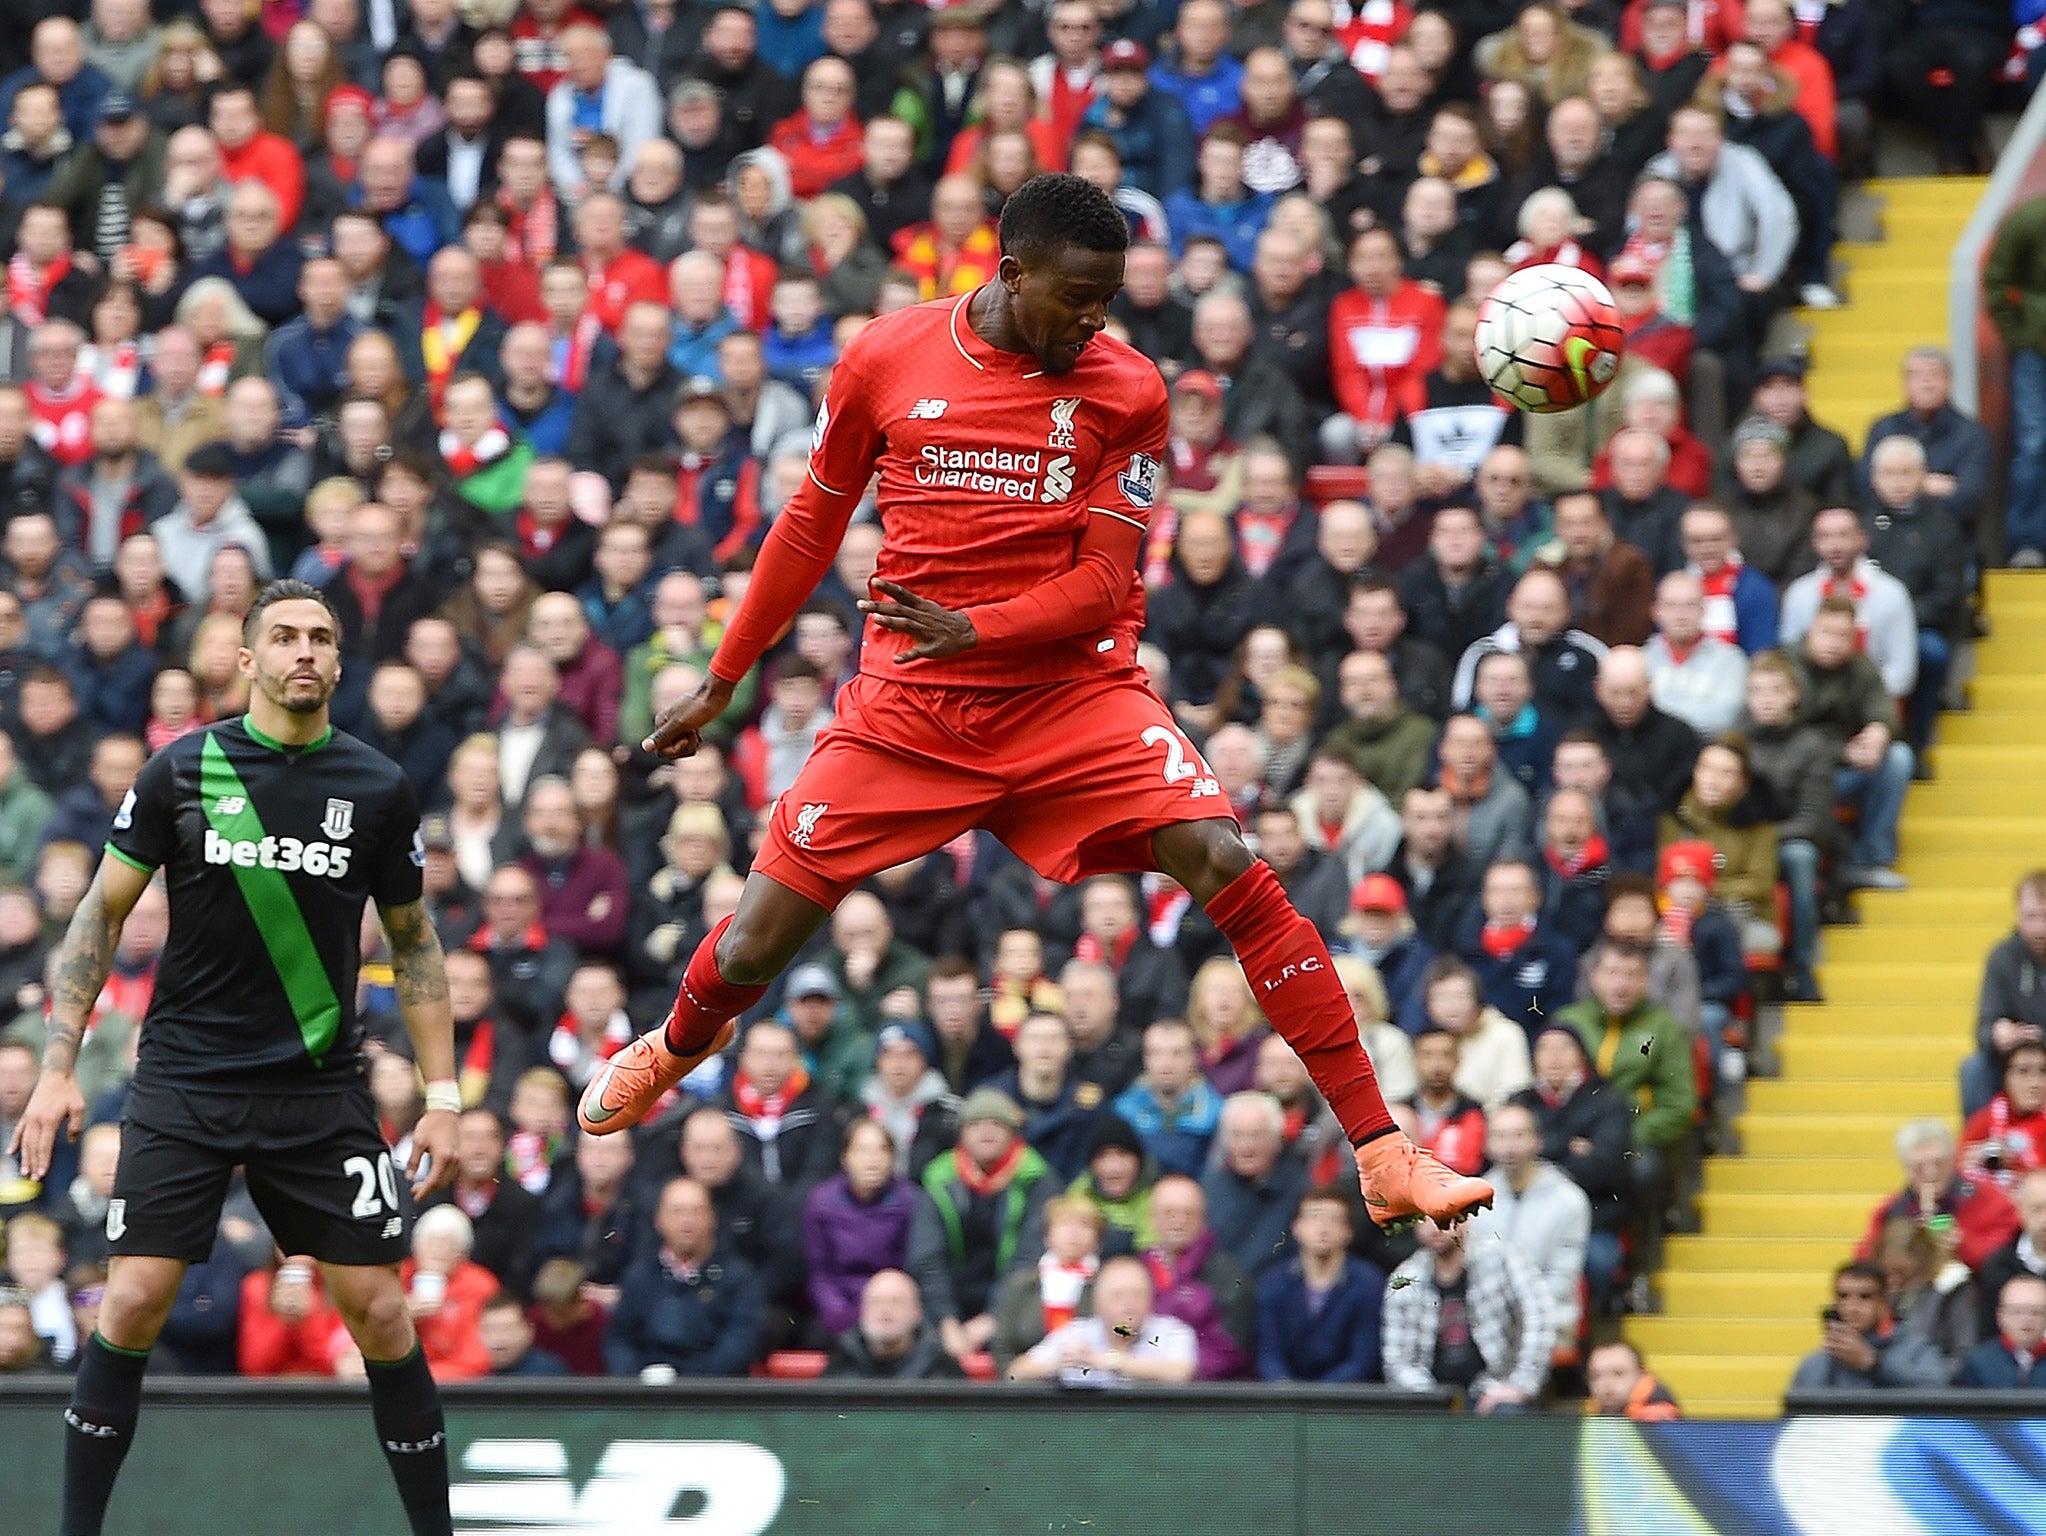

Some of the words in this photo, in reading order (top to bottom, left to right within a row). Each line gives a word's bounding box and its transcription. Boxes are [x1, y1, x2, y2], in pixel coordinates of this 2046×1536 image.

[920, 445, 1041, 474] Standard
[915, 464, 1037, 502] Chartered
[204, 829, 352, 879] bet365
[343, 1151, 399, 1218] 20
